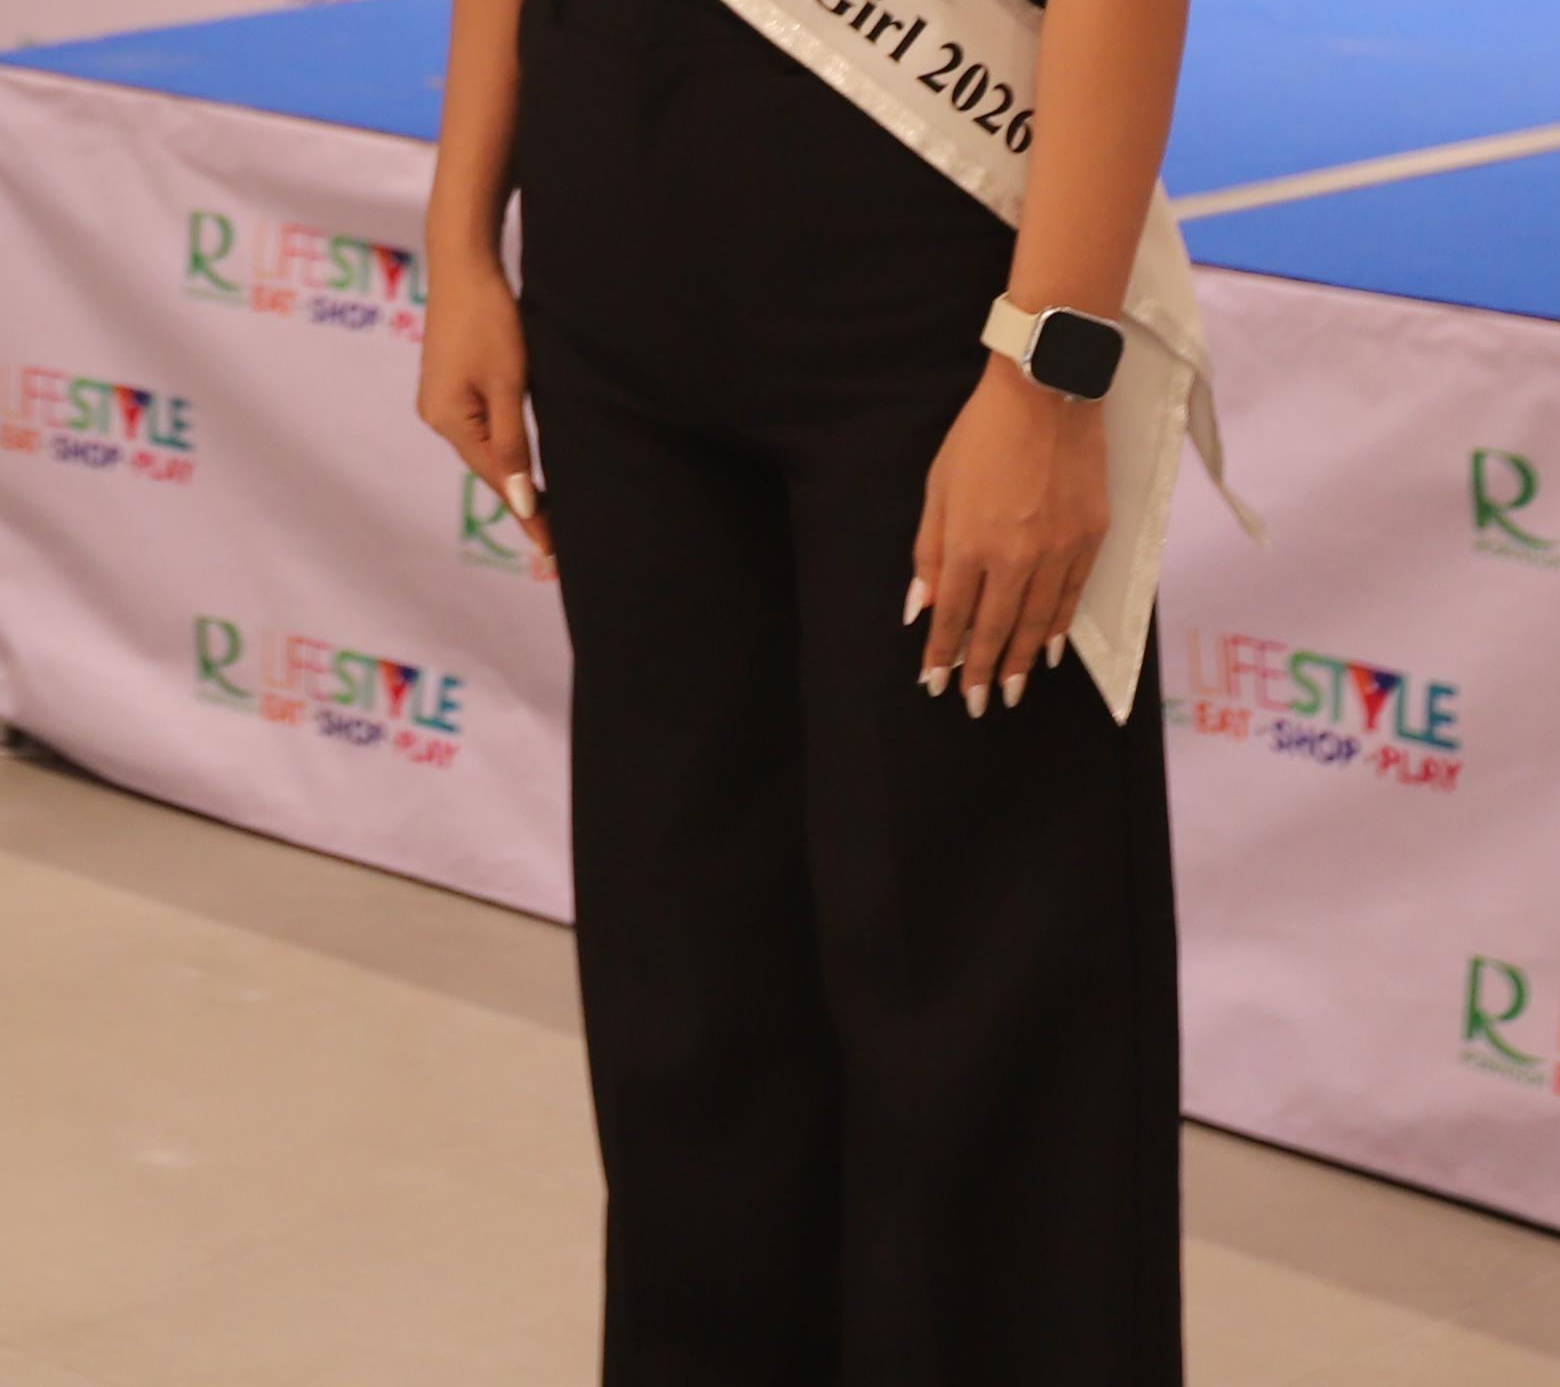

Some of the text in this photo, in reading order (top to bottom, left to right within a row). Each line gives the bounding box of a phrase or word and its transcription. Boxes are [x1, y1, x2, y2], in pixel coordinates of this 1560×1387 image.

[917, 42, 1036, 154] 2026
[189, 210, 428, 305] R LIFESTYL
[1469, 447, 1560, 549] R
[195, 616, 464, 734] R LIFESTYLE
[1186, 629, 1460, 751] LIFESTYLE
[1194, 701, 1463, 792] EAT SHOP PLAY
[1464, 954, 1542, 1065] R
